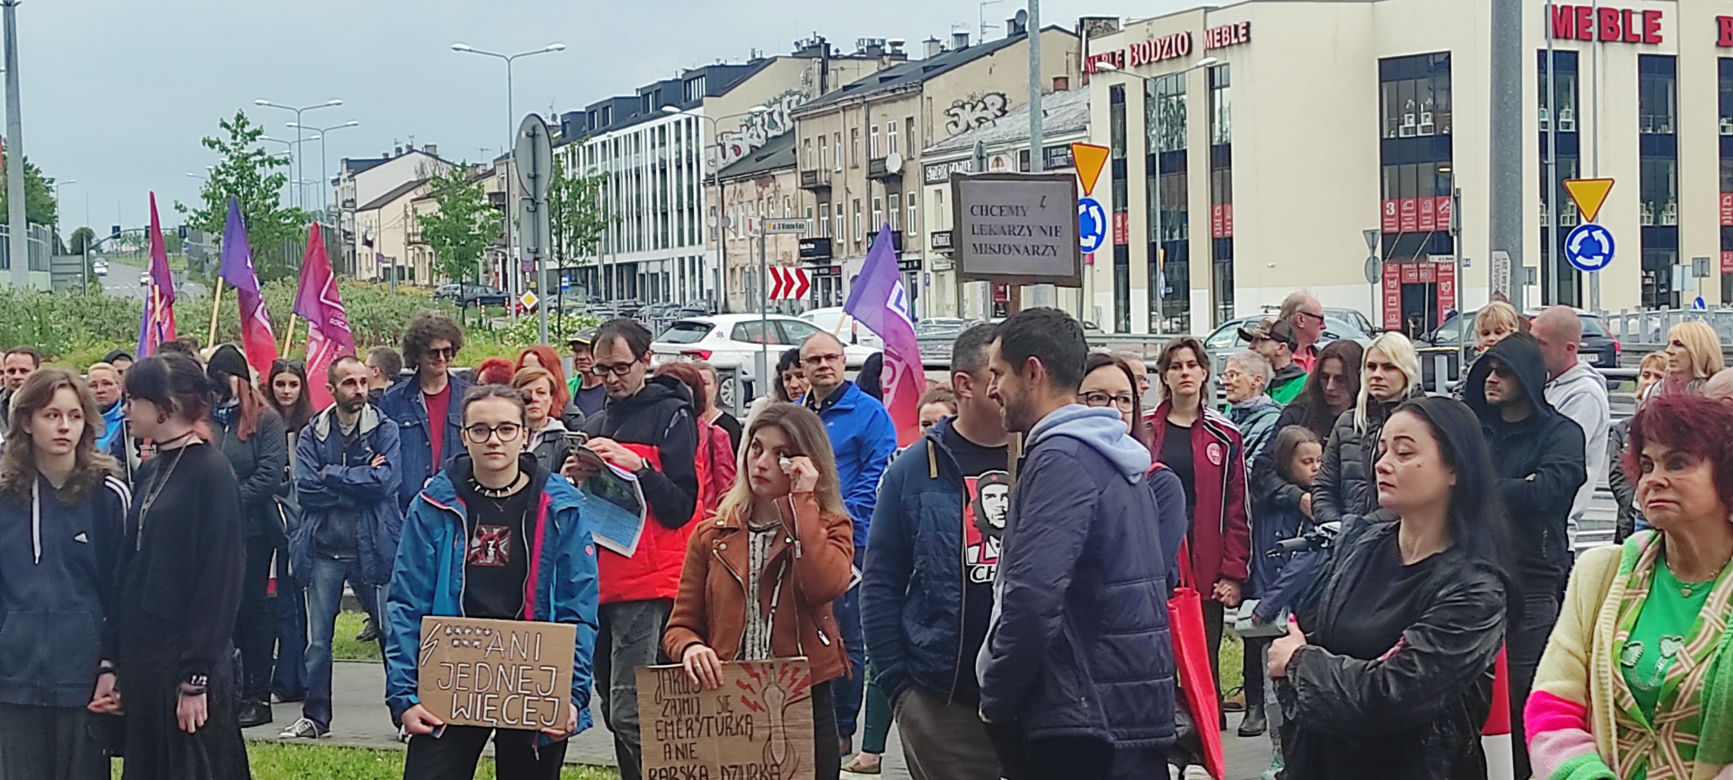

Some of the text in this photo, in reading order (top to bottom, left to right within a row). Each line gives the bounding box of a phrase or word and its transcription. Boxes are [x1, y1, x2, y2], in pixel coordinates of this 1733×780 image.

[1545, 4, 1663, 45] MEBLE
[1129, 31, 1192, 67] BODZIO
[1203, 21, 1251, 51] MEBLE
[970, 204, 1029, 217] CHCEMY
[971, 223, 1062, 238] LEKARZY NIE
[972, 242, 1059, 257] MISJONARZY
[484, 631, 542, 660] ANI
[437, 661, 558, 697] JEDNEJ
[451, 693, 560, 727] WIĘCEJ
[675, 742, 699, 761] NIE
